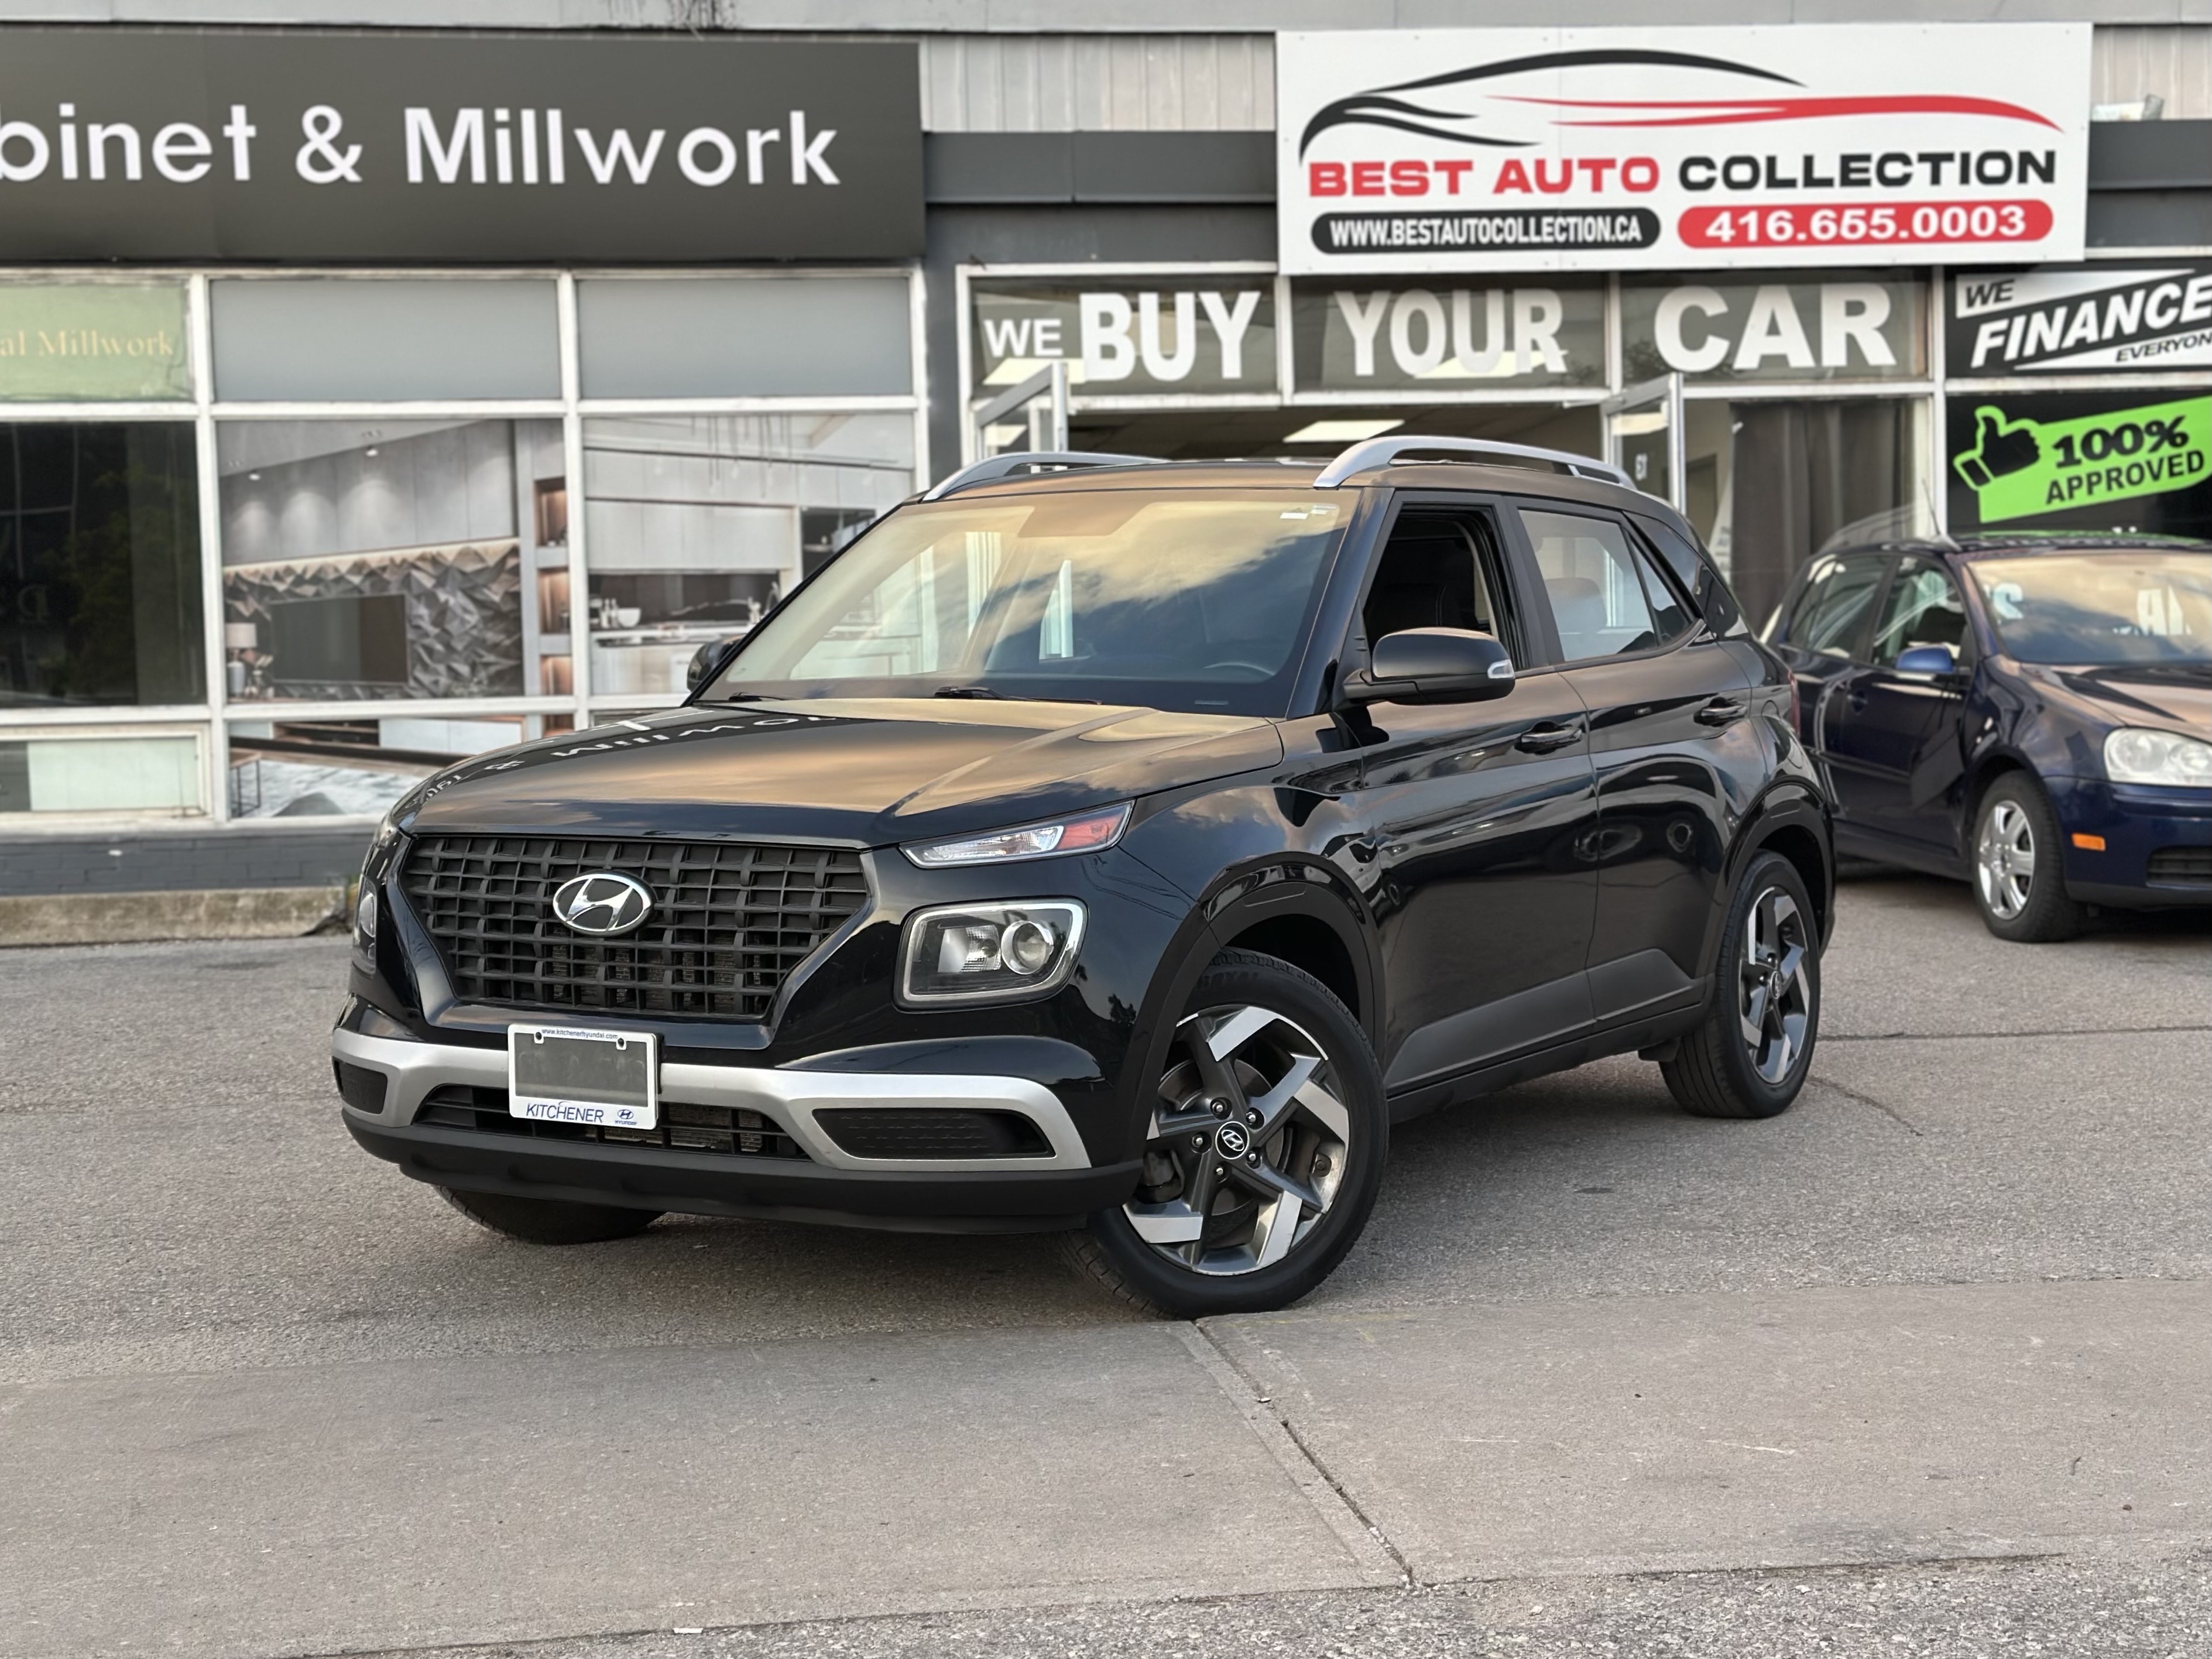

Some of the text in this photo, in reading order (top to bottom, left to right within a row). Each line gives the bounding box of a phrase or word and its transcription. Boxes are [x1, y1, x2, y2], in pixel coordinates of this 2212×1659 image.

[296, 105, 363, 183] &
[404, 108, 840, 186] Millwork
[1309, 150, 2056, 197] BEST AUTO COLLECTION
[1329, 215, 1642, 246] WWW.BESTAUTOCOLLECTION.CA
[1965, 279, 2015, 309] WE
[38, 330, 174, 357] Millwork
[985, 282, 1897, 381] WE BUY YOUR CAR
[1970, 273, 2212, 369] FINANCE
[2052, 415, 2190, 468] 100%
[2045, 449, 2205, 505] APPROVED
[526, 1103, 604, 1123] KITCHENER
